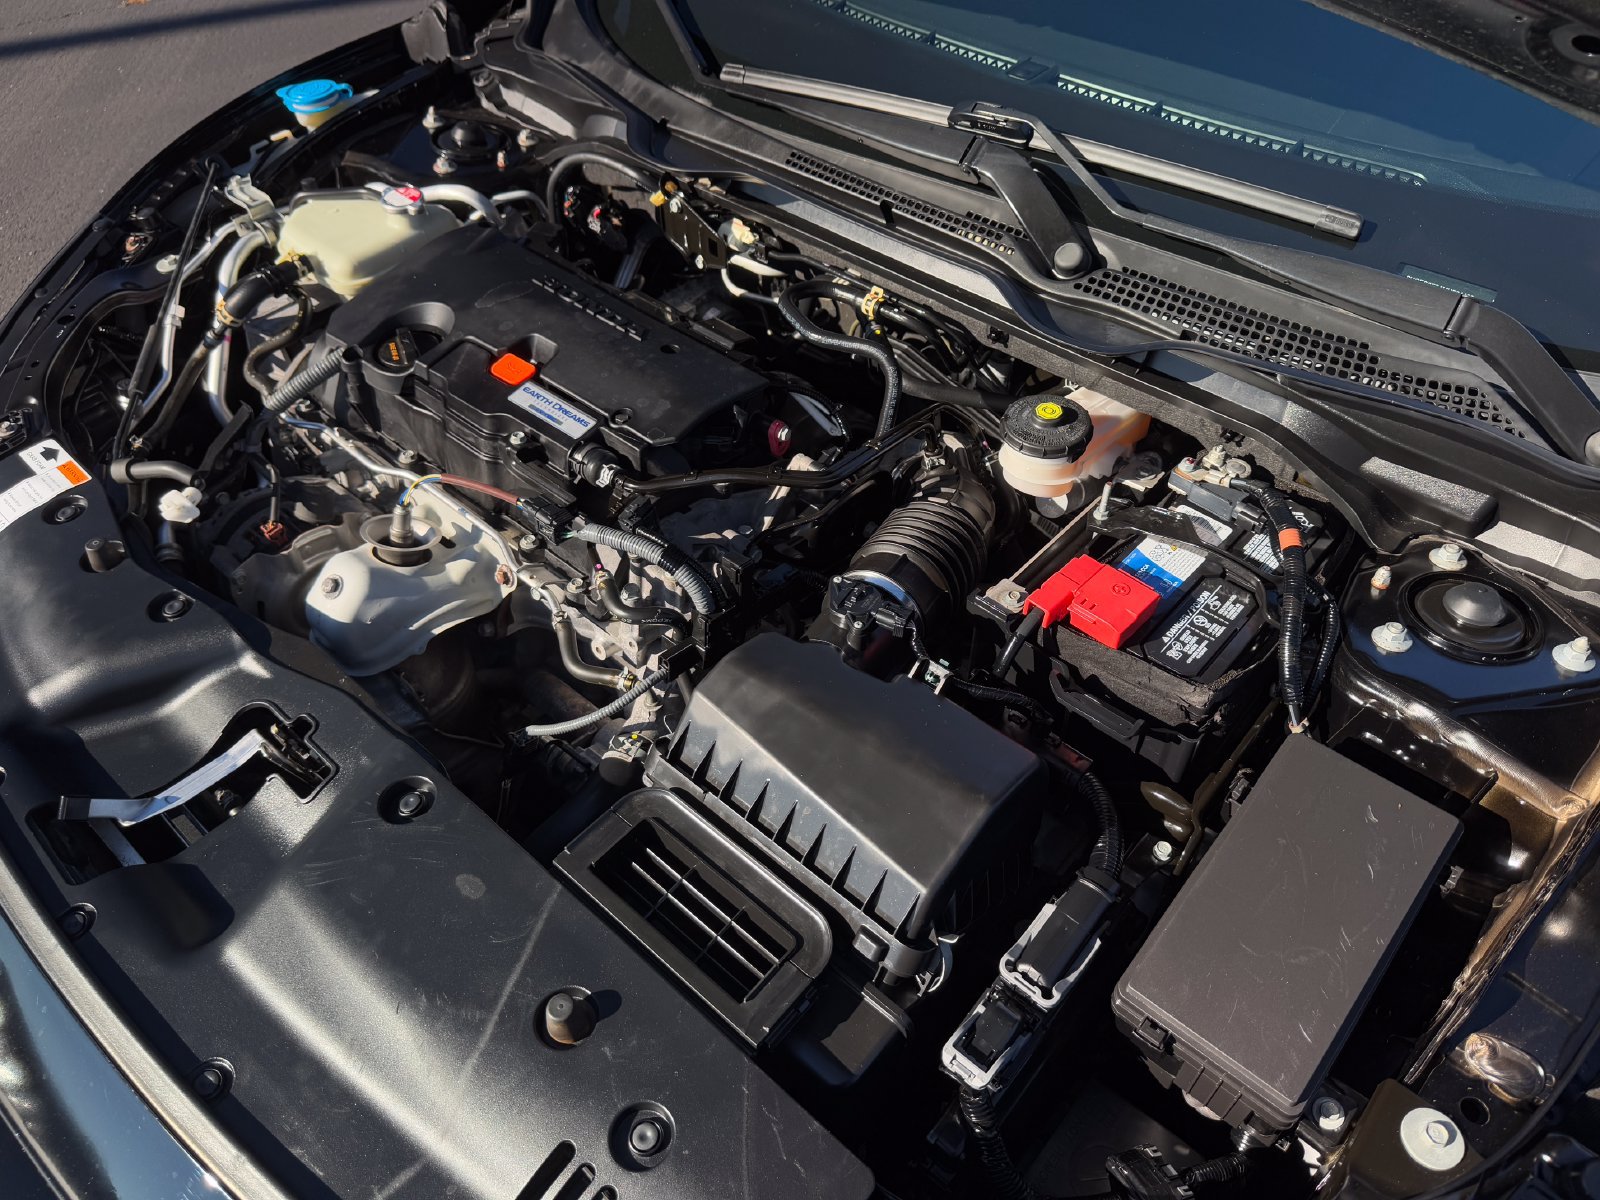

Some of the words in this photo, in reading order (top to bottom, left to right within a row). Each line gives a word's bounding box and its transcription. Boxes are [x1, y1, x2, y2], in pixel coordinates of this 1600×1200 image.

[522, 386, 554, 406] EARTH
[552, 402, 591, 428] DREAMS
[1165, 613, 1190, 638] DANGER
[1189, 590, 1211, 612] POISON
